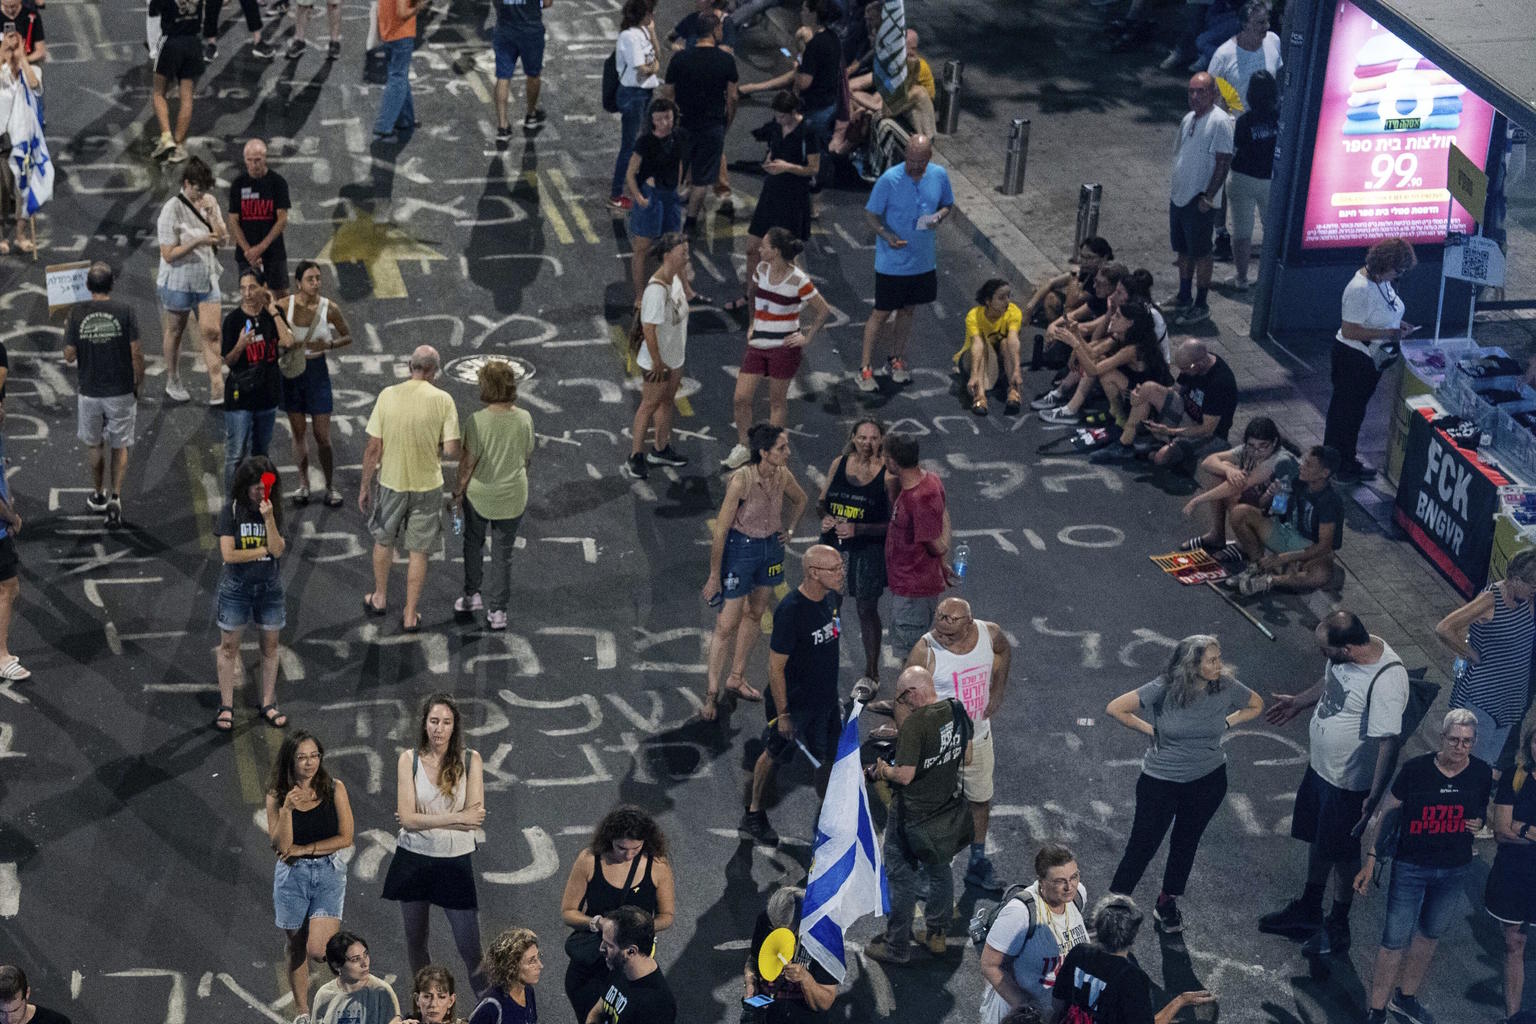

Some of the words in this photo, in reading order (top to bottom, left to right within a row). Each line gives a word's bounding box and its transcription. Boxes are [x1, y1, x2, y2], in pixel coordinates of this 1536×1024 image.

[1343, 139, 1373, 153] ספר
[1376, 138, 1402, 152] בית
[1406, 135, 1457, 150] חולצות
[241, 199, 274, 217] NOW!
[1425, 437, 1471, 521] FCK
[1416, 491, 1464, 557] BNGVR
[811, 628, 824, 645] 75
[1422, 804, 1464, 821] כולנו
